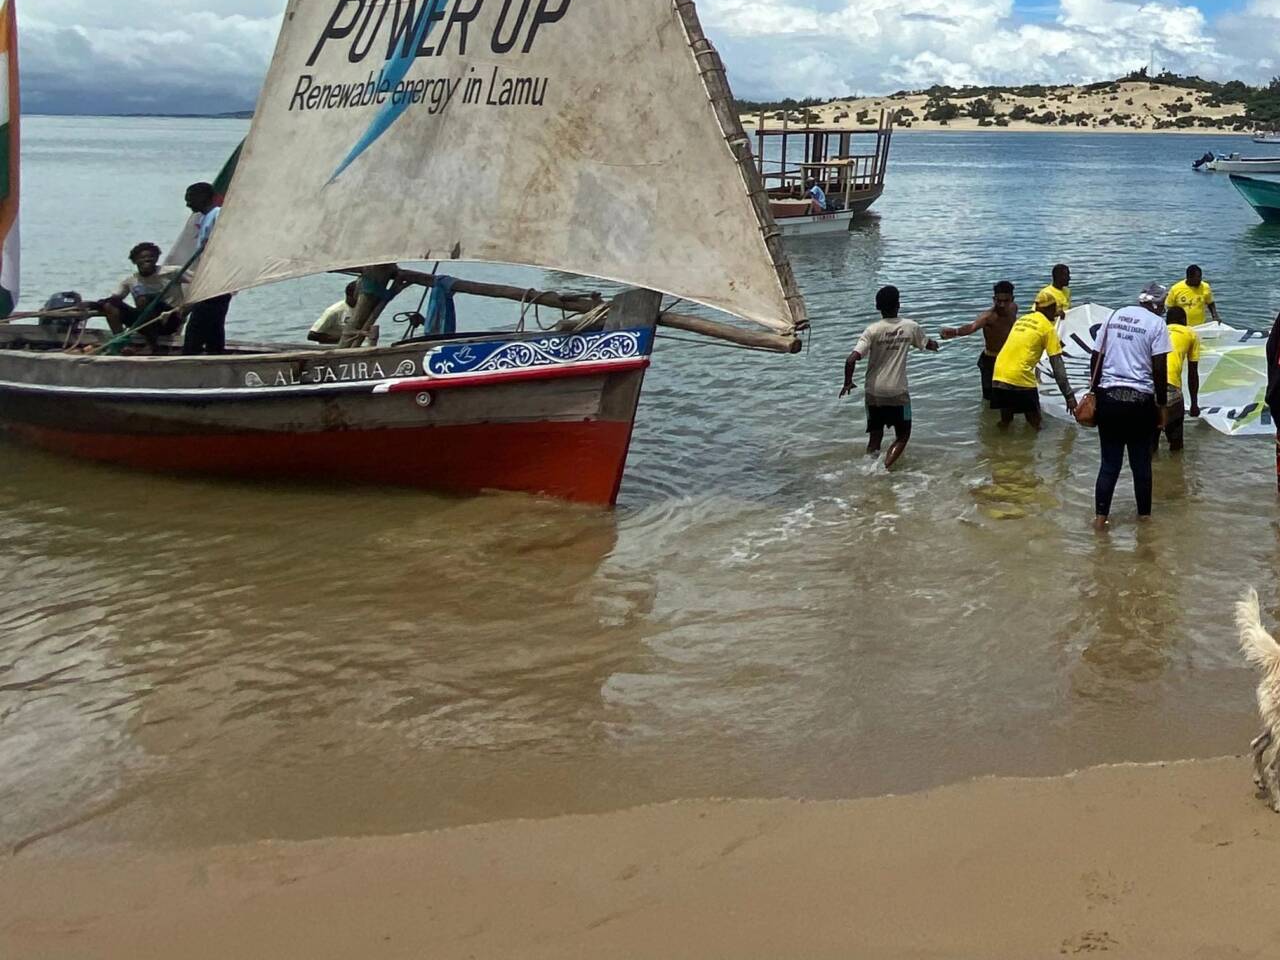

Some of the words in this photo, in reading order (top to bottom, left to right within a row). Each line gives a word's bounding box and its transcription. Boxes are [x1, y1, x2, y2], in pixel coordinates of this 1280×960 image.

[288, 69, 387, 112] Renewable
[391, 77, 461, 115] energy
[462, 66, 482, 105] in
[486, 66, 549, 107] Lamu
[274, 361, 386, 387] AL-JAZIRA
